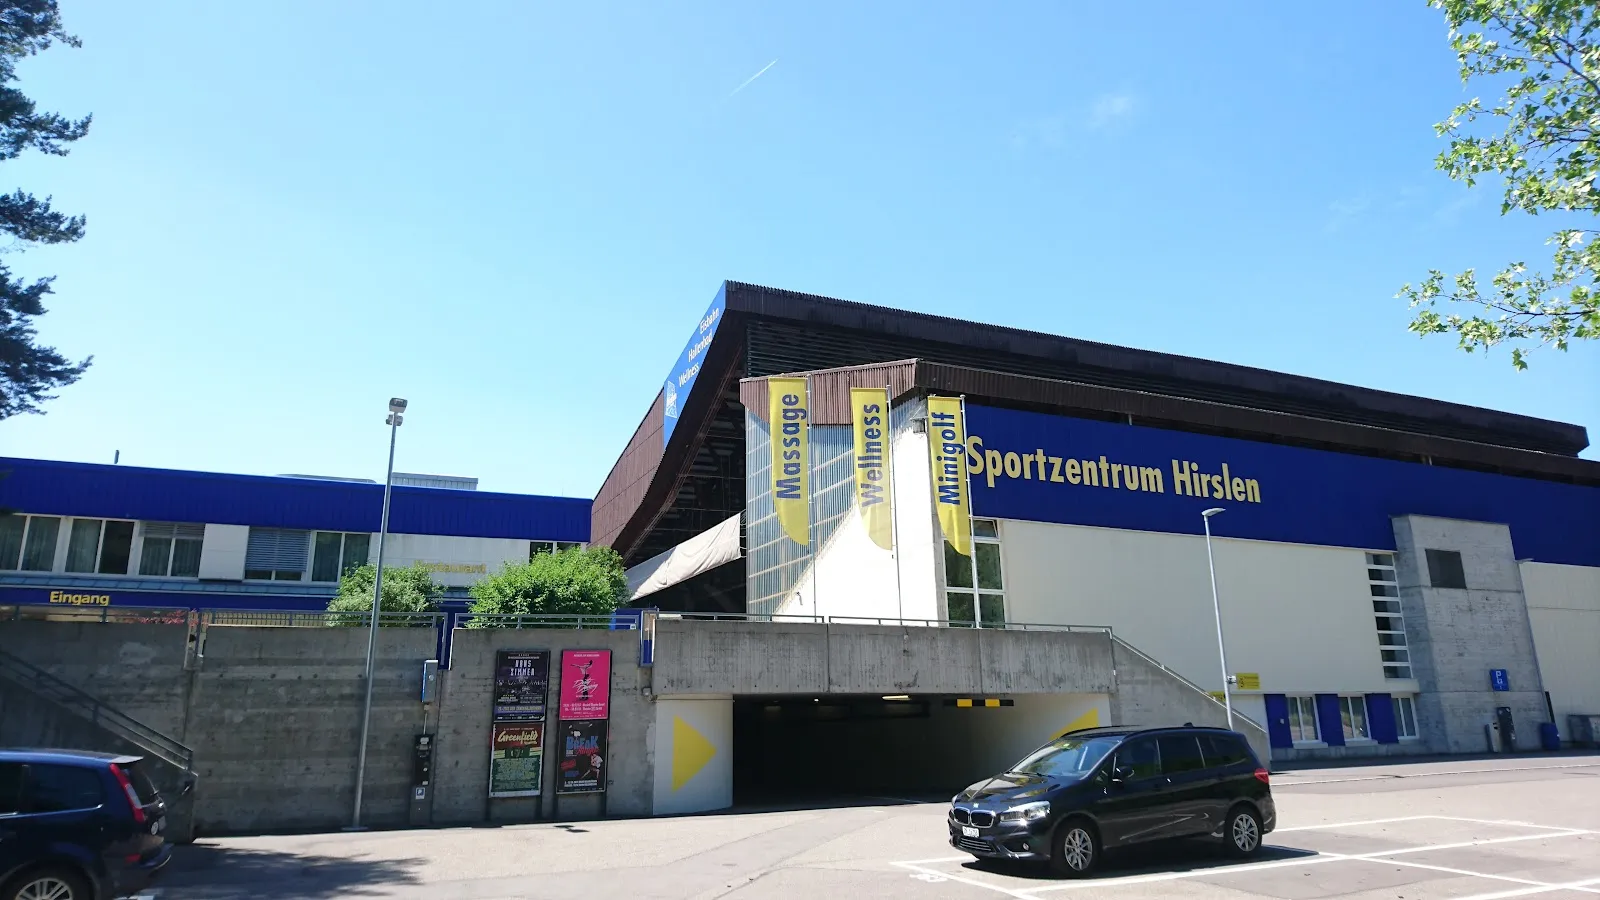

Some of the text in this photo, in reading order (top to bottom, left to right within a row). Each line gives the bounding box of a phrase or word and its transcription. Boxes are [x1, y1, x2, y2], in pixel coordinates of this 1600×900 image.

[700, 308, 719, 334] Eisbahn
[688, 329, 713, 362] Hallenbad
[678, 362, 700, 387] Wellness
[776, 394, 806, 499] Massage
[858, 404, 884, 507] Wellness
[931, 412, 964, 506] Minigolf
[966, 435, 1262, 503] Sportzentrum Hirslen
[414, 560, 486, 573] staurant
[49, 591, 110, 606] Eingang
[498, 730, 538, 745] Greenfield
